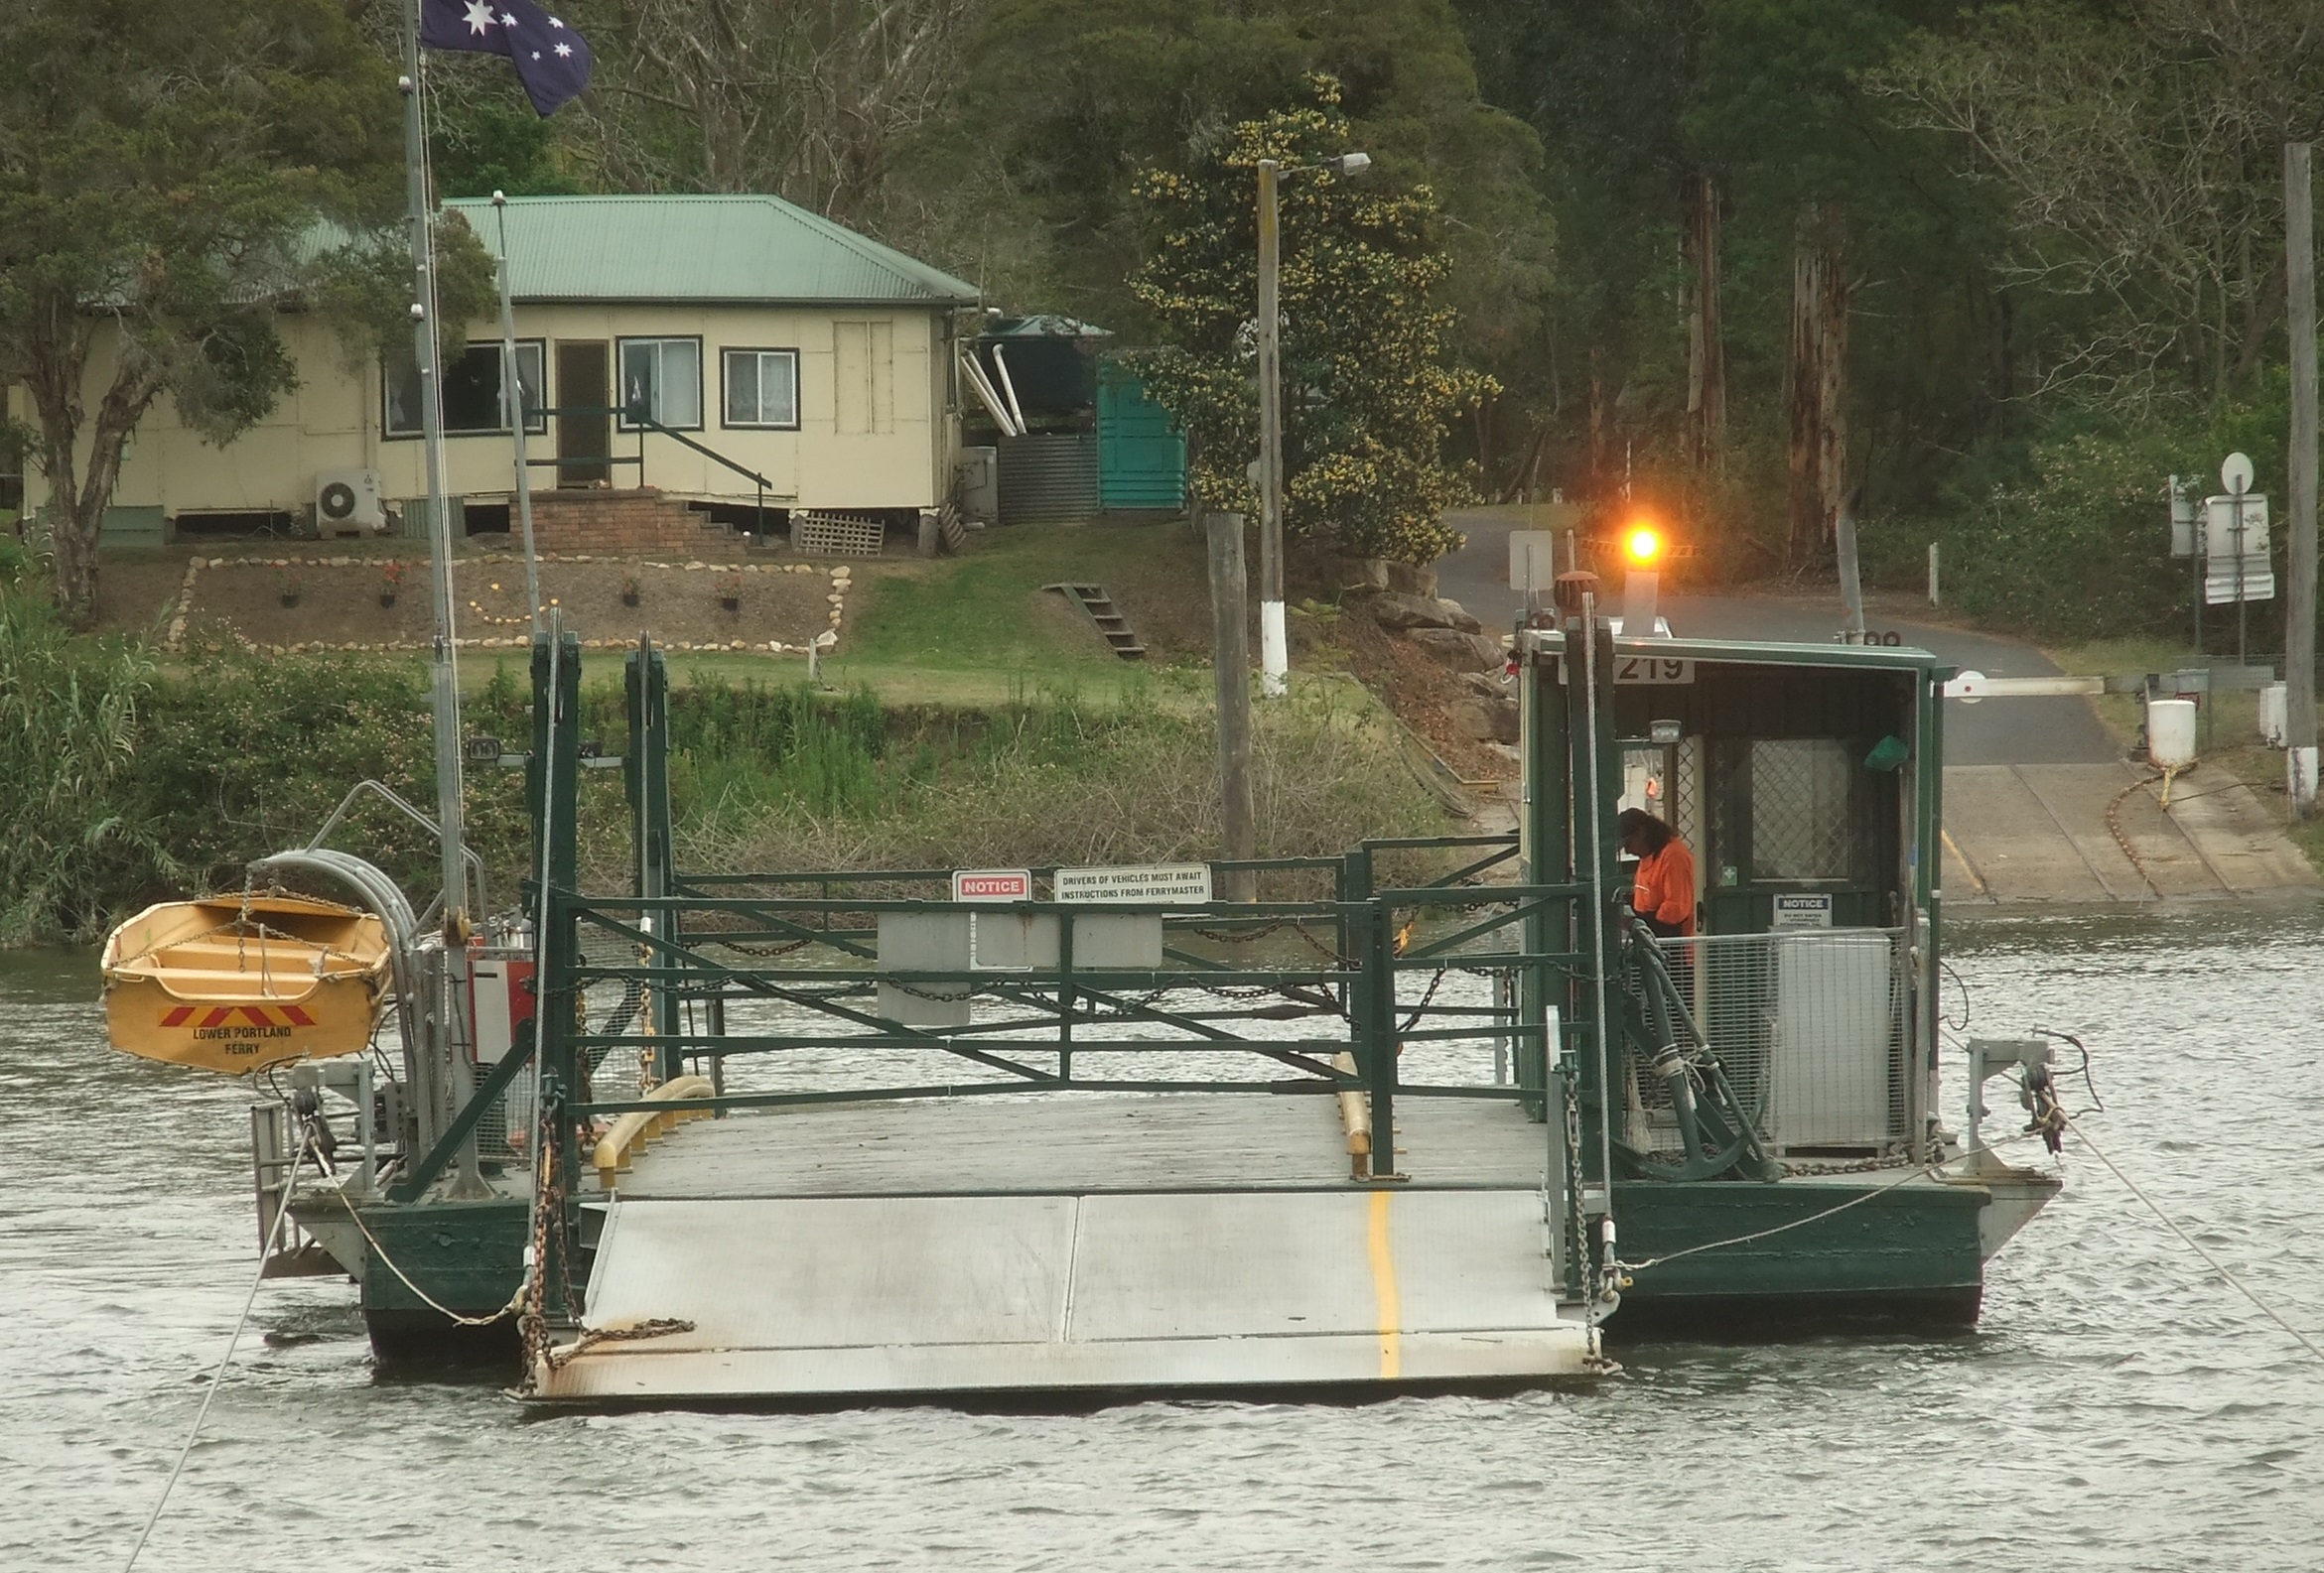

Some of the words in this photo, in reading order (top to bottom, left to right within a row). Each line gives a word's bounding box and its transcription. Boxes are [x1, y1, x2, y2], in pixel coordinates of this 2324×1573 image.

[1619, 658, 1684, 680] 219
[1062, 874, 1097, 886] DRIVERS
[1098, 874, 1109, 884] OF
[1111, 873, 1150, 883] VEHICLES
[1151, 872, 1173, 882] MUST
[1175, 871, 1202, 881] AWAIT
[964, 880, 1021, 893] NOTICE
[1061, 888, 1119, 899] INSTRUCTIONS
[1121, 887, 1144, 897] FROM
[1146, 885, 1204, 896] FERRYMASTER
[1783, 899, 1824, 908] NOTICE
[193, 1028, 231, 1040] LOWER
[234, 1026, 292, 1038] PORTLAND
[225, 1043, 260, 1055] FERRY
